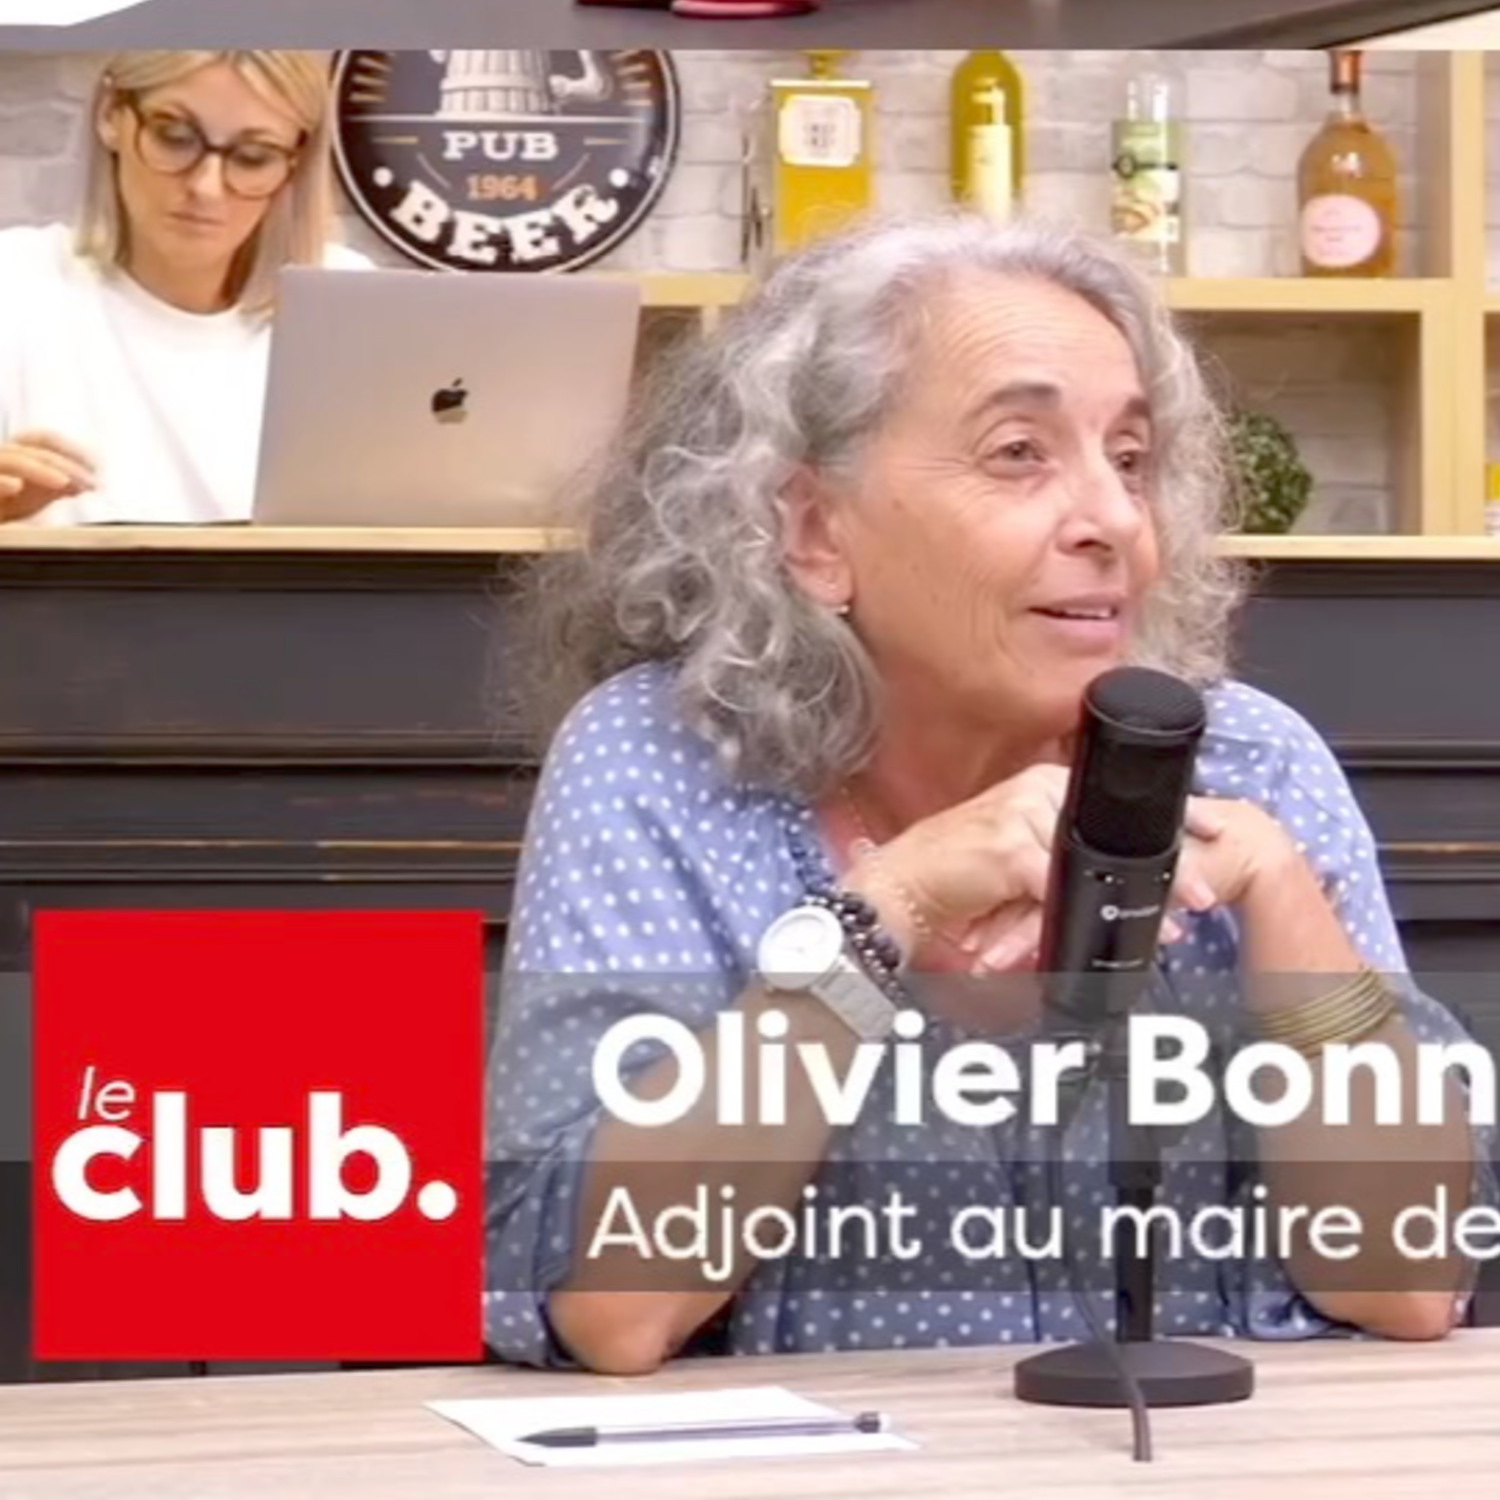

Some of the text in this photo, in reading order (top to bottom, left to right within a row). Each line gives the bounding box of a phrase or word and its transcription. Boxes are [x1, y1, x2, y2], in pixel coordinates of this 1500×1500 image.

[442, 130, 558, 160] PUB
[466, 174, 540, 202] 1964
[389, 178, 620, 264] BEER
